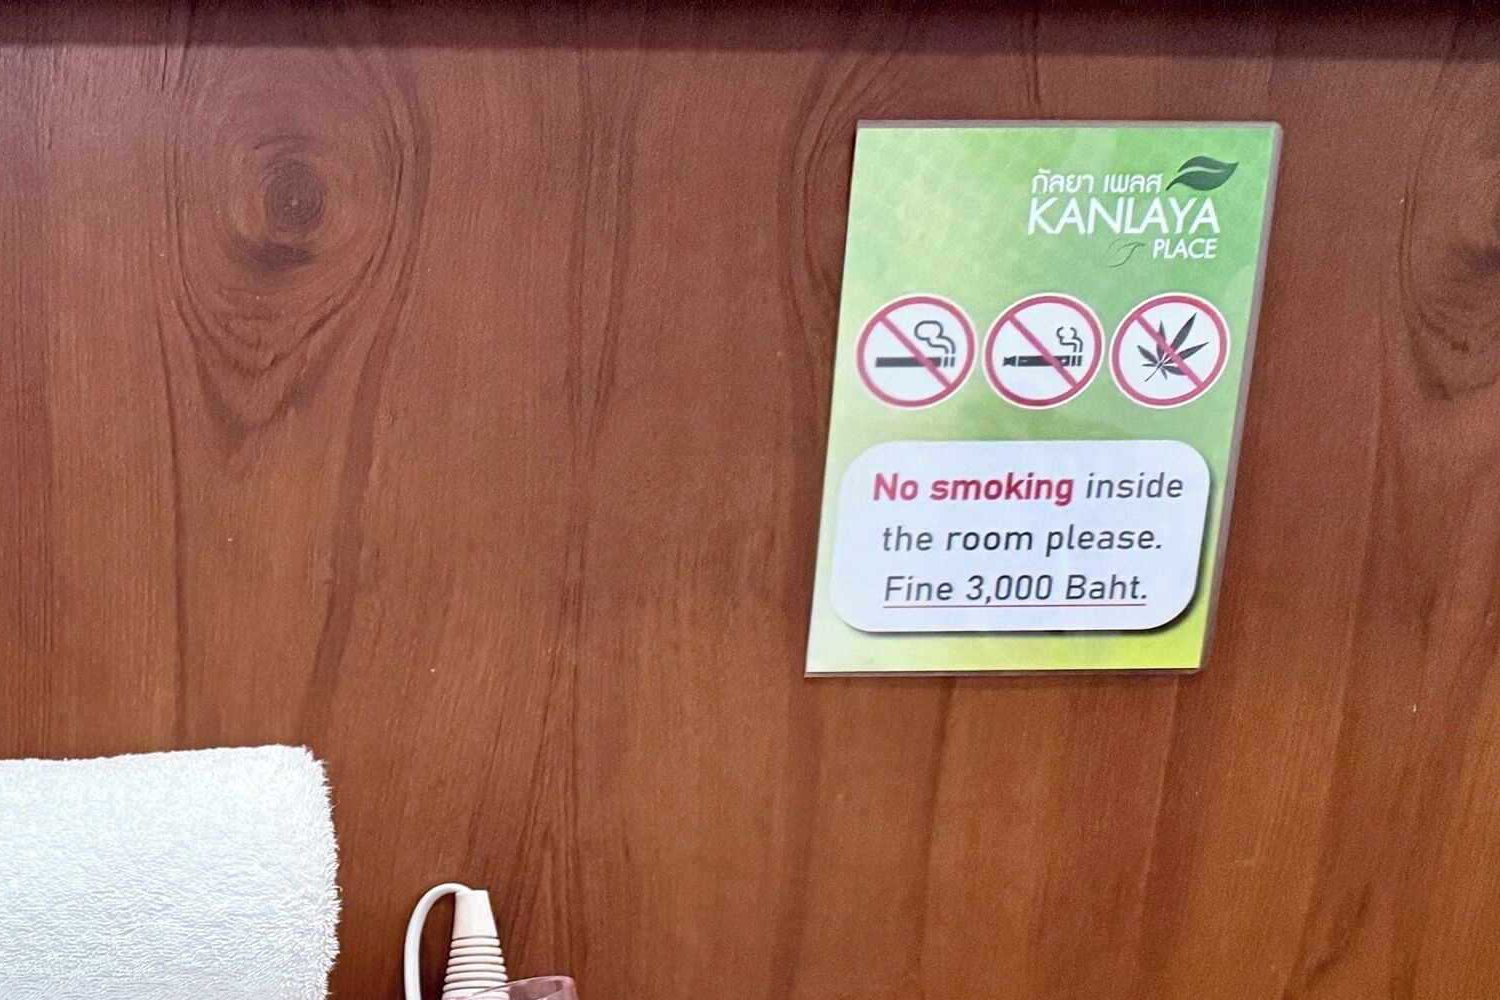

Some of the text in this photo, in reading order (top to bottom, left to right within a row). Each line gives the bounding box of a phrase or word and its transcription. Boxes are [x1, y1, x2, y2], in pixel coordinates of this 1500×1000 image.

[1031, 168, 1163, 194] กัลยา เพลส
[1027, 196, 1221, 235] KANLAYA
[1152, 238, 1218, 259] PLACE
[872, 471, 1183, 506] No smoking inside
[882, 524, 1162, 557] the room please.
[884, 573, 1147, 605] Fine 3,000 Baht.
